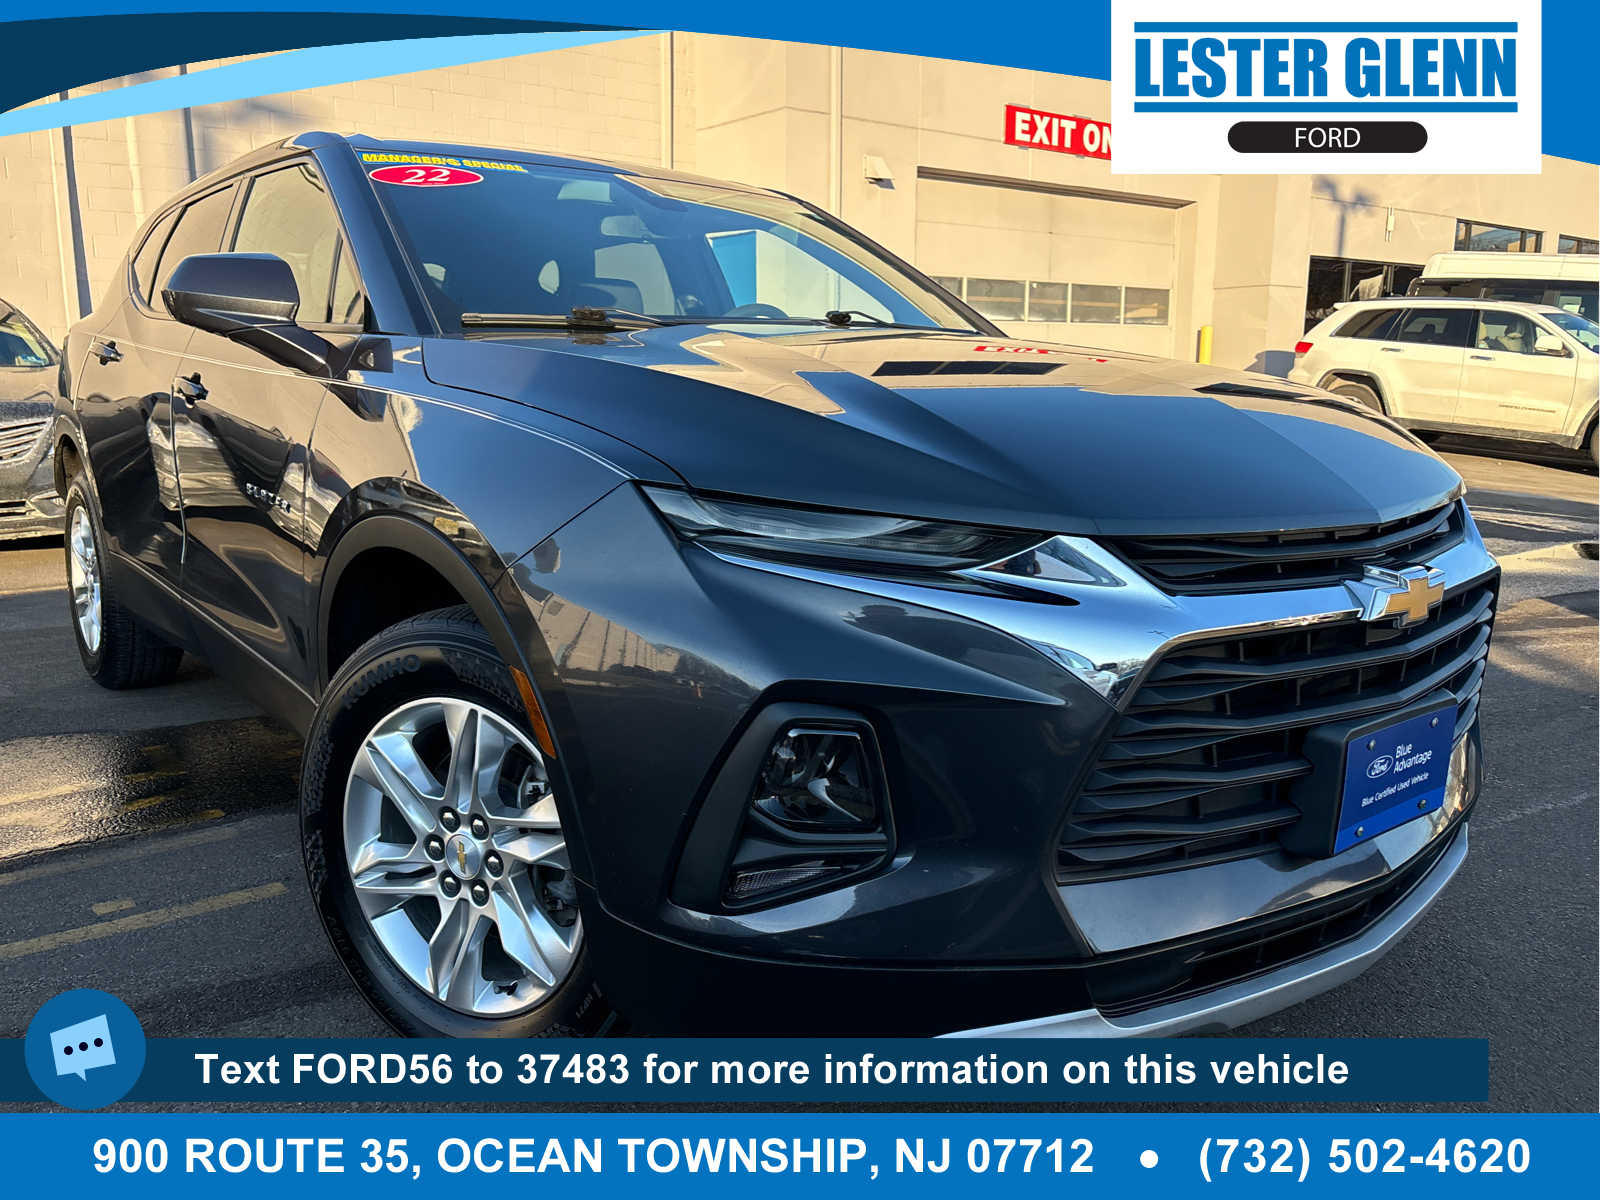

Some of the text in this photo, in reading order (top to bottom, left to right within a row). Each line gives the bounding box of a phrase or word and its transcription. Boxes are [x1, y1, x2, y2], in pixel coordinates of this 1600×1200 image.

[1014, 111, 1077, 148] EXIT
[402, 168, 451, 183] 22
[462, 159, 529, 172] SPECIAL
[342, 654, 421, 709] KUMHO
[1395, 743, 1413, 759] Blue
[1371, 758, 1389, 776] Ford
[1393, 750, 1432, 774] Advantage
[1361, 772, 1429, 807] Blue Certified Used Vehicle
